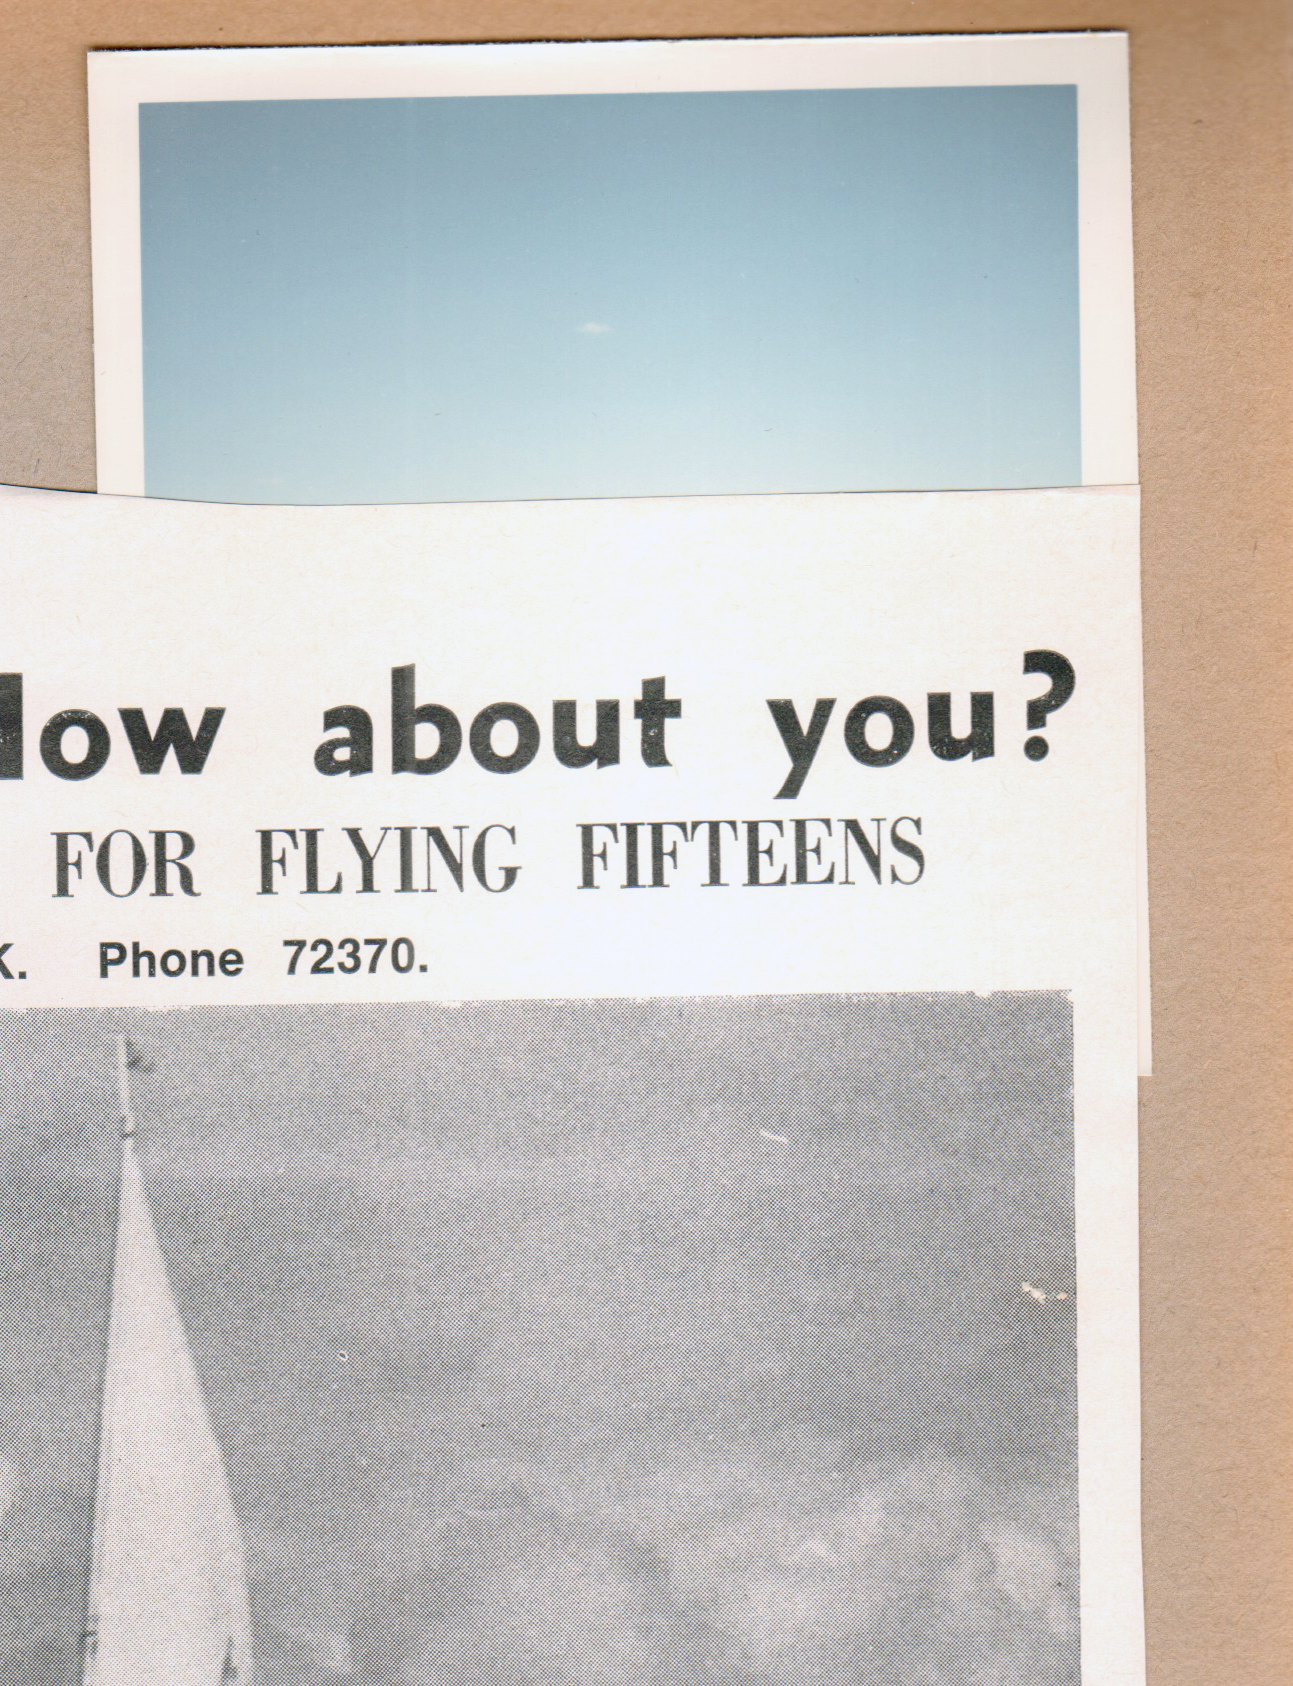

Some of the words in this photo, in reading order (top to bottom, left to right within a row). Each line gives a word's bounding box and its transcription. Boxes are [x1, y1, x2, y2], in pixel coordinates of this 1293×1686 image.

[315, 666, 681, 775] about
[768, 650, 1075, 799] you?
[54, 830, 197, 897] FOR
[257, 826, 518, 894] FLYING
[580, 817, 924, 888] FIFTEENS
[100, 942, 243, 978] Phone
[284, 938, 427, 974] 72370.
